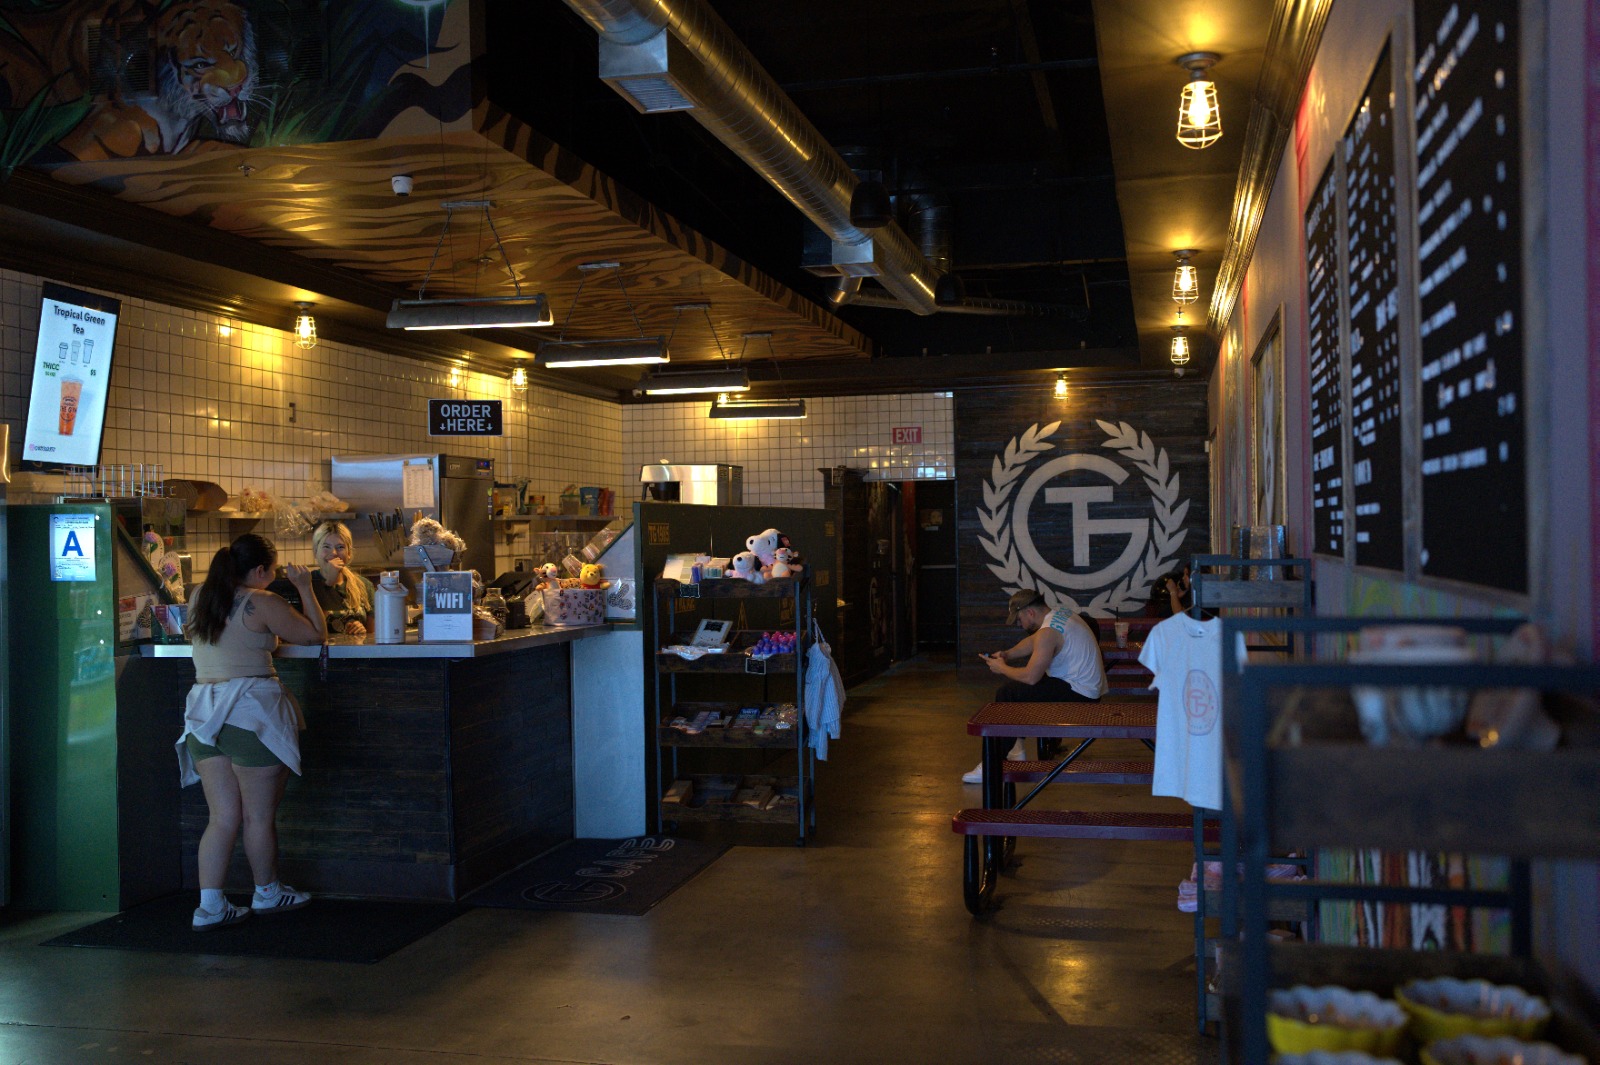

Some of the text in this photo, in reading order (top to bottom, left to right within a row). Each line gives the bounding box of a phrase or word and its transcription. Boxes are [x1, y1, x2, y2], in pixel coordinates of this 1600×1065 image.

[54, 304, 106, 325] Tropical Green
[72, 324, 85, 335] Tea
[440, 404, 491, 418] ORDER
[447, 418, 486, 432] HERE
[896, 428, 919, 442] EXIT
[62, 530, 84, 557] A
[435, 592, 464, 609] WIFI
